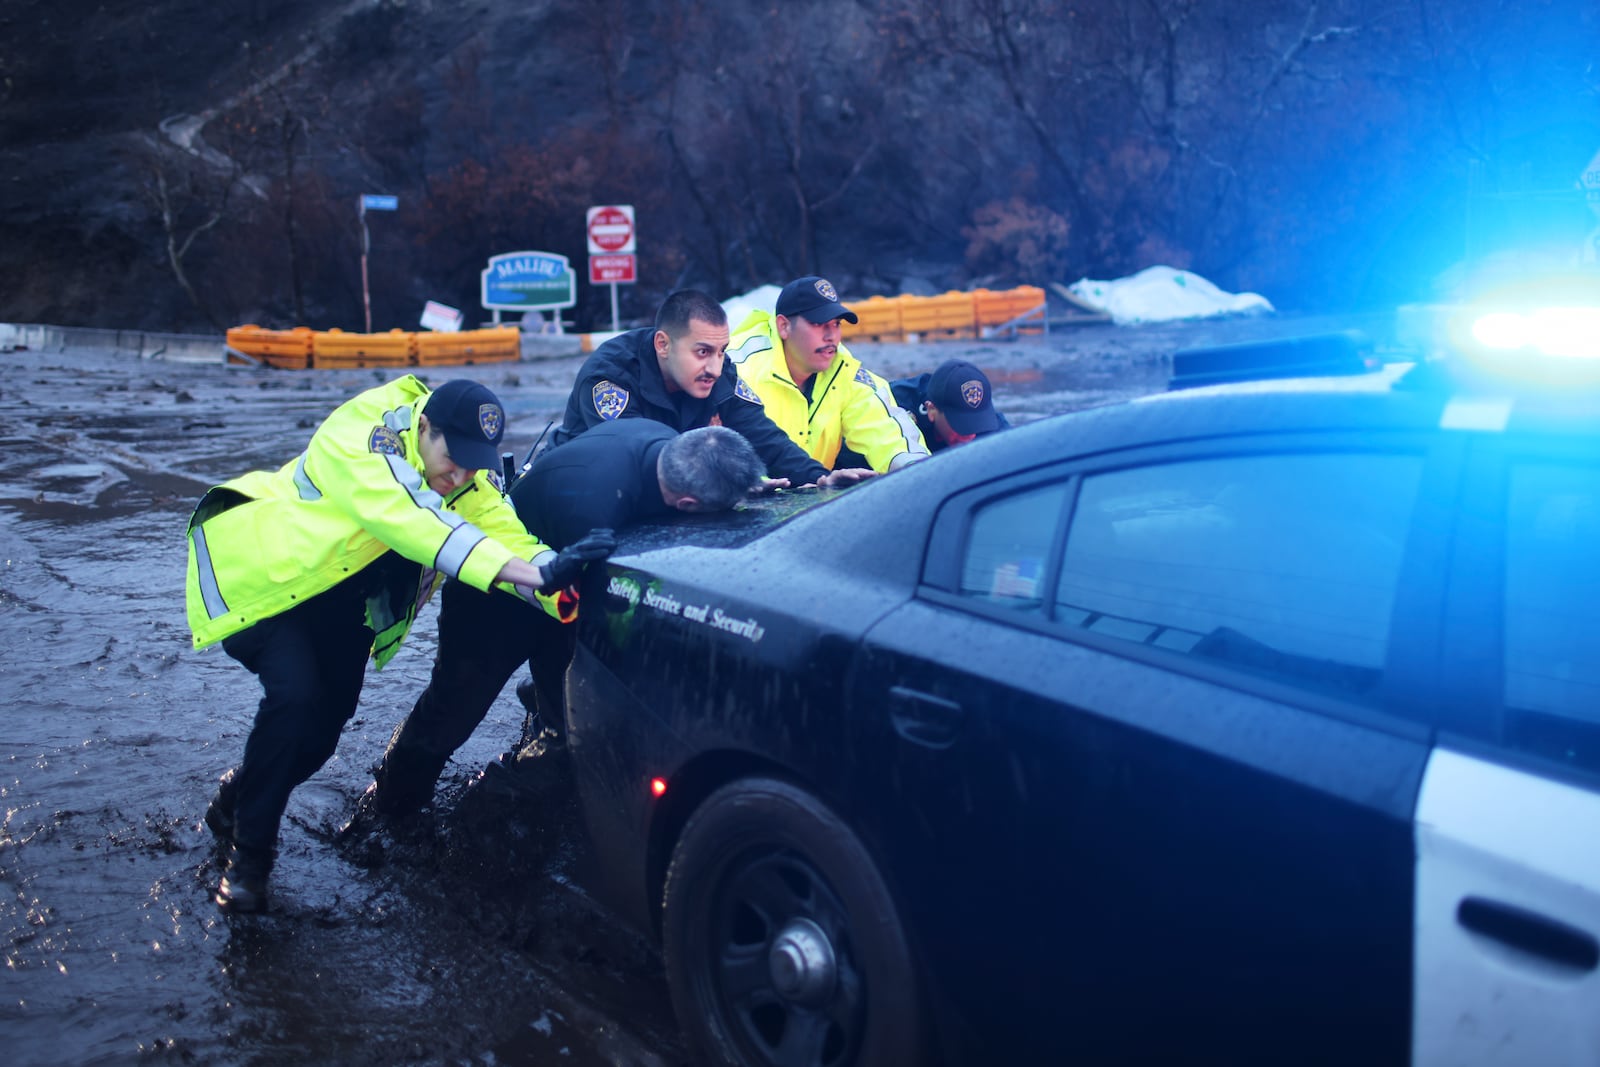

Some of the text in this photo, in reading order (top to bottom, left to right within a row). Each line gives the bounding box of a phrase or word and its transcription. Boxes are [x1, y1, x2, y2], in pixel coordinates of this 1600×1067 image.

[497, 258, 561, 279] MALIBU
[643, 587, 682, 615] Service
[683, 604, 710, 623] and
[710, 608, 765, 642] Security
